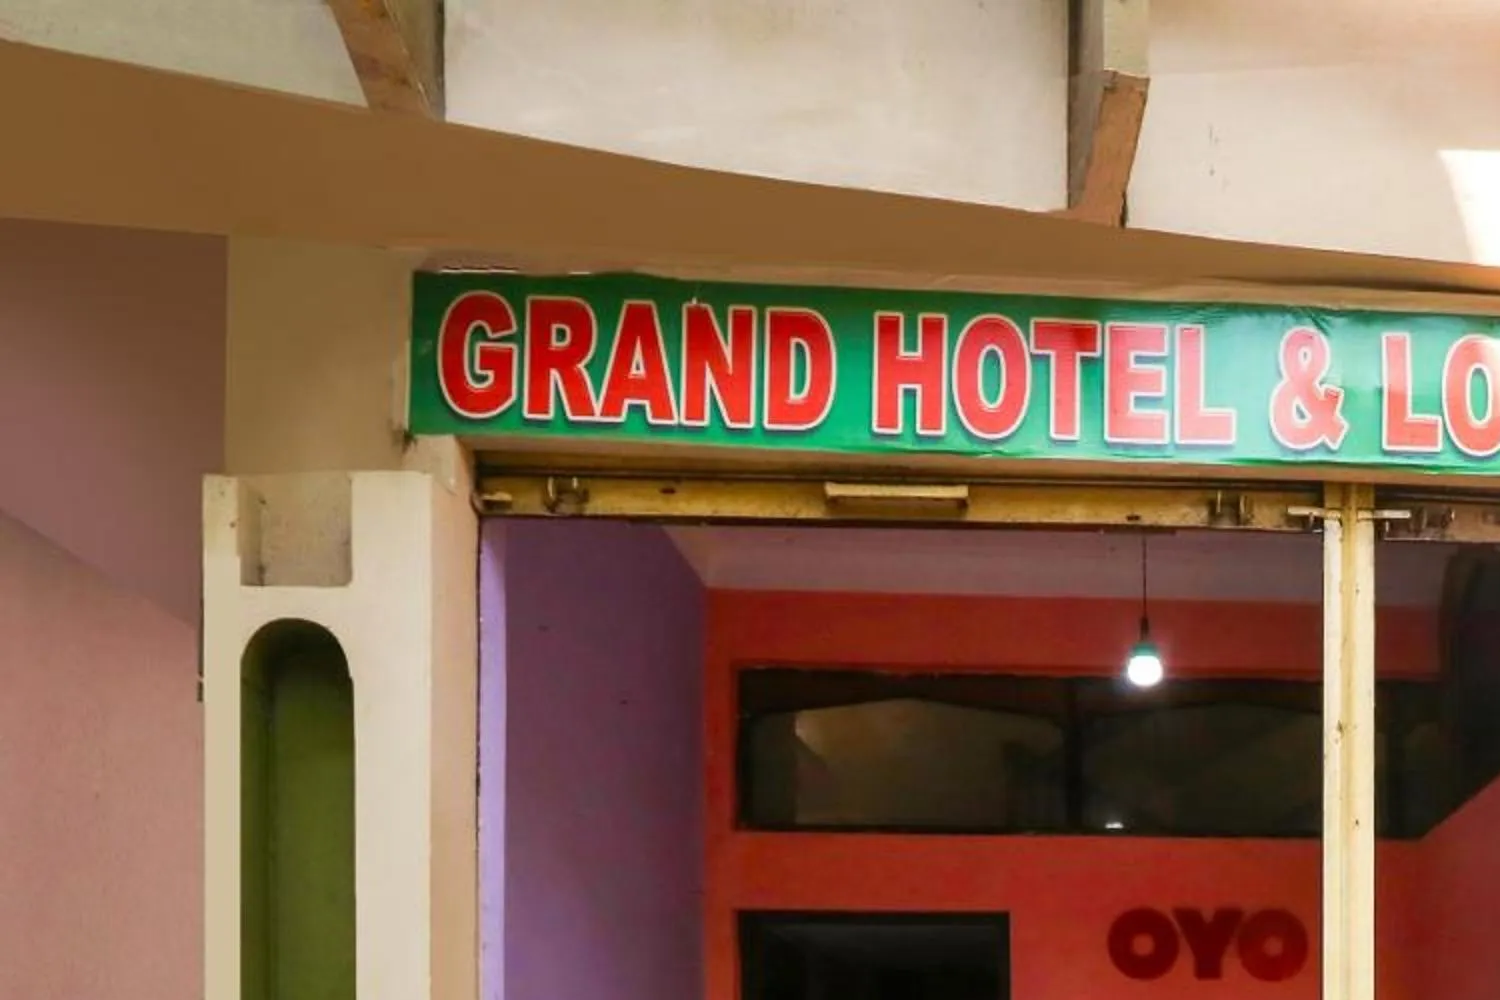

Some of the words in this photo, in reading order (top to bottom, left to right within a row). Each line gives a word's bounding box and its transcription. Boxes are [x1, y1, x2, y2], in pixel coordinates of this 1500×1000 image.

[437, 291, 837, 431] GRAND
[872, 311, 1237, 446] HOTEL
[1269, 326, 1350, 451] &
[1107, 907, 1309, 982] OYO
